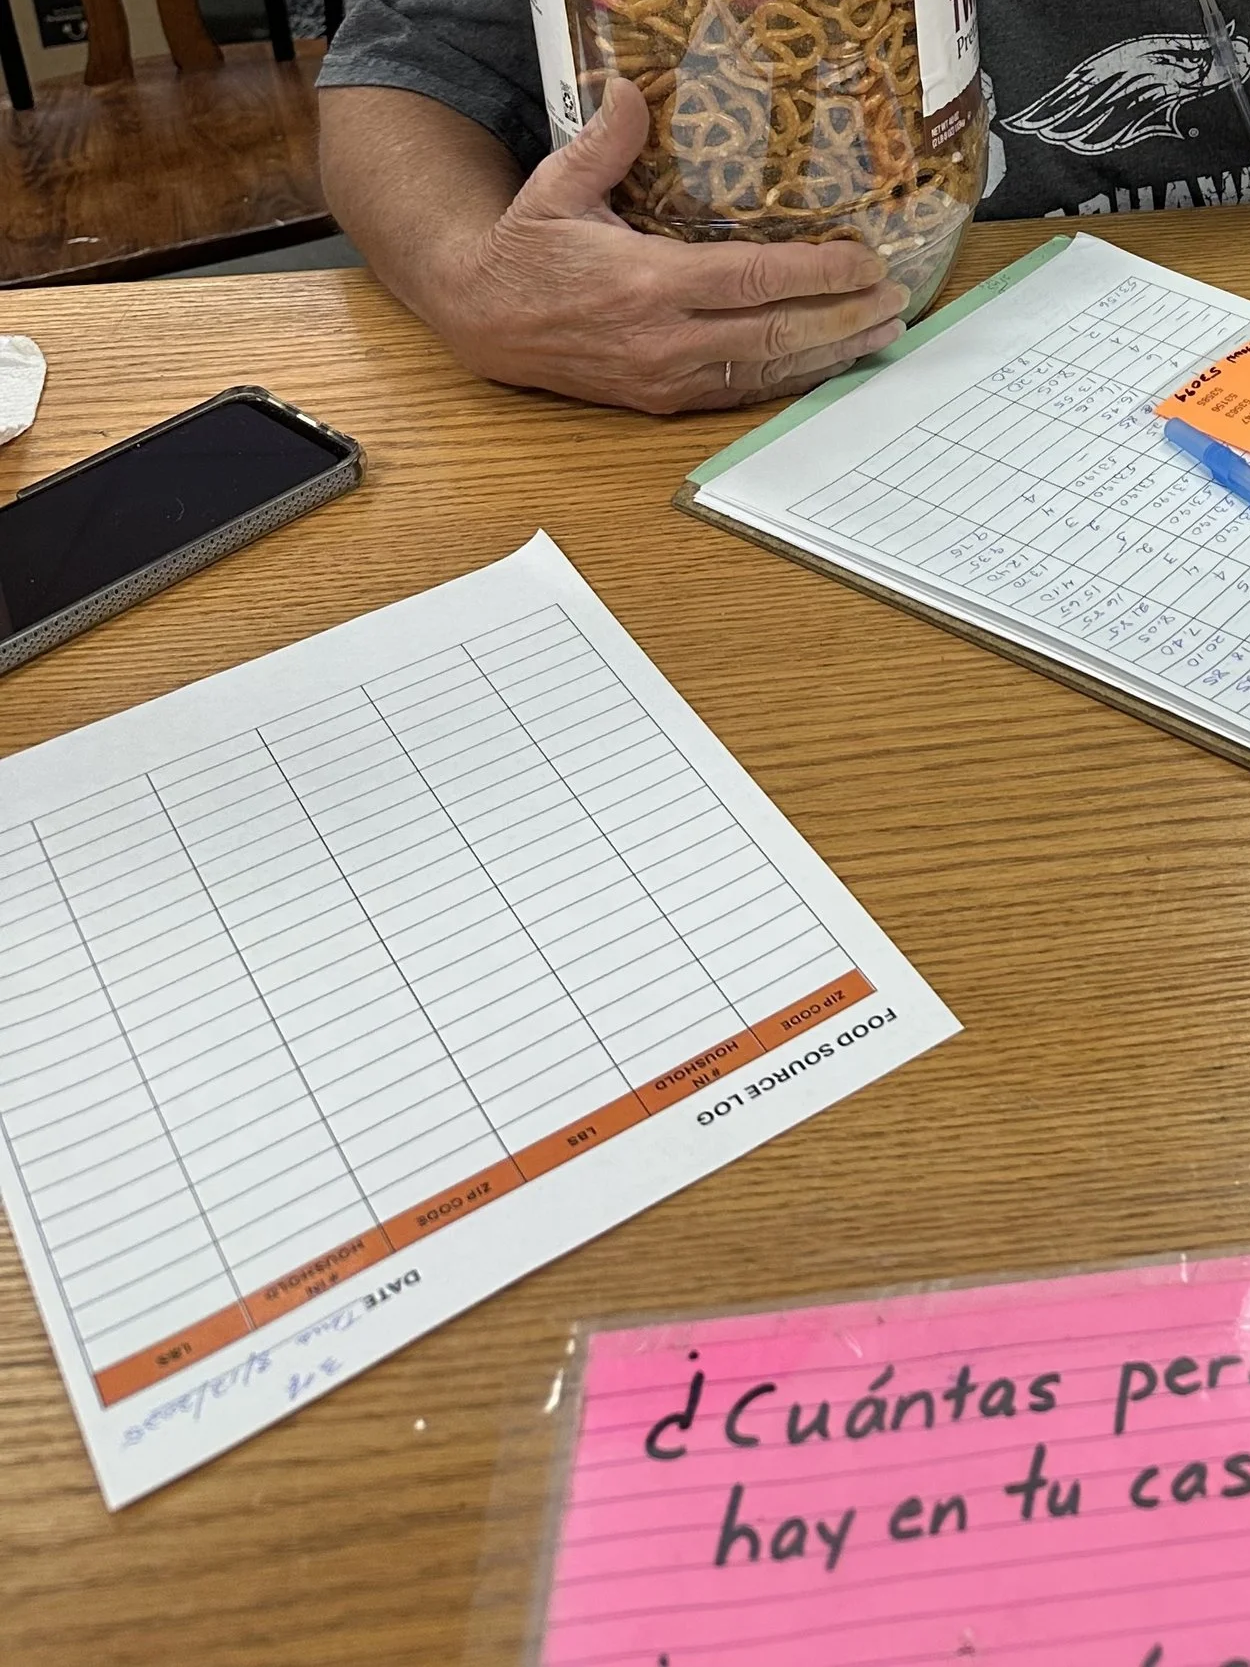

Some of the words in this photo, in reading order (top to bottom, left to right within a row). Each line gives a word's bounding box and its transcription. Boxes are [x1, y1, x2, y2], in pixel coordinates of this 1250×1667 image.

[778, 1003, 822, 1031] CODE
[819, 989, 846, 1007] ZIP
[832, 1006, 899, 1049] FOOD
[651, 1039, 739, 1091] HOUSHOLD
[690, 1072, 711, 1088] IN
[742, 1041, 837, 1099] SOURCE
[693, 1092, 745, 1128] LOG
[565, 1125, 597, 1147] LBS
[464, 1180, 492, 1201] ZIP
[415, 1195, 464, 1228] CODE
[260, 1237, 366, 1302] HOUSHOLD
[359, 1267, 423, 1311] DATE
[645, 1351, 1061, 1461] ¿Cuántas
[713, 1482, 856, 1572] hay
[888, 1494, 968, 1542] en
[1003, 1442, 1082, 1521] tu
